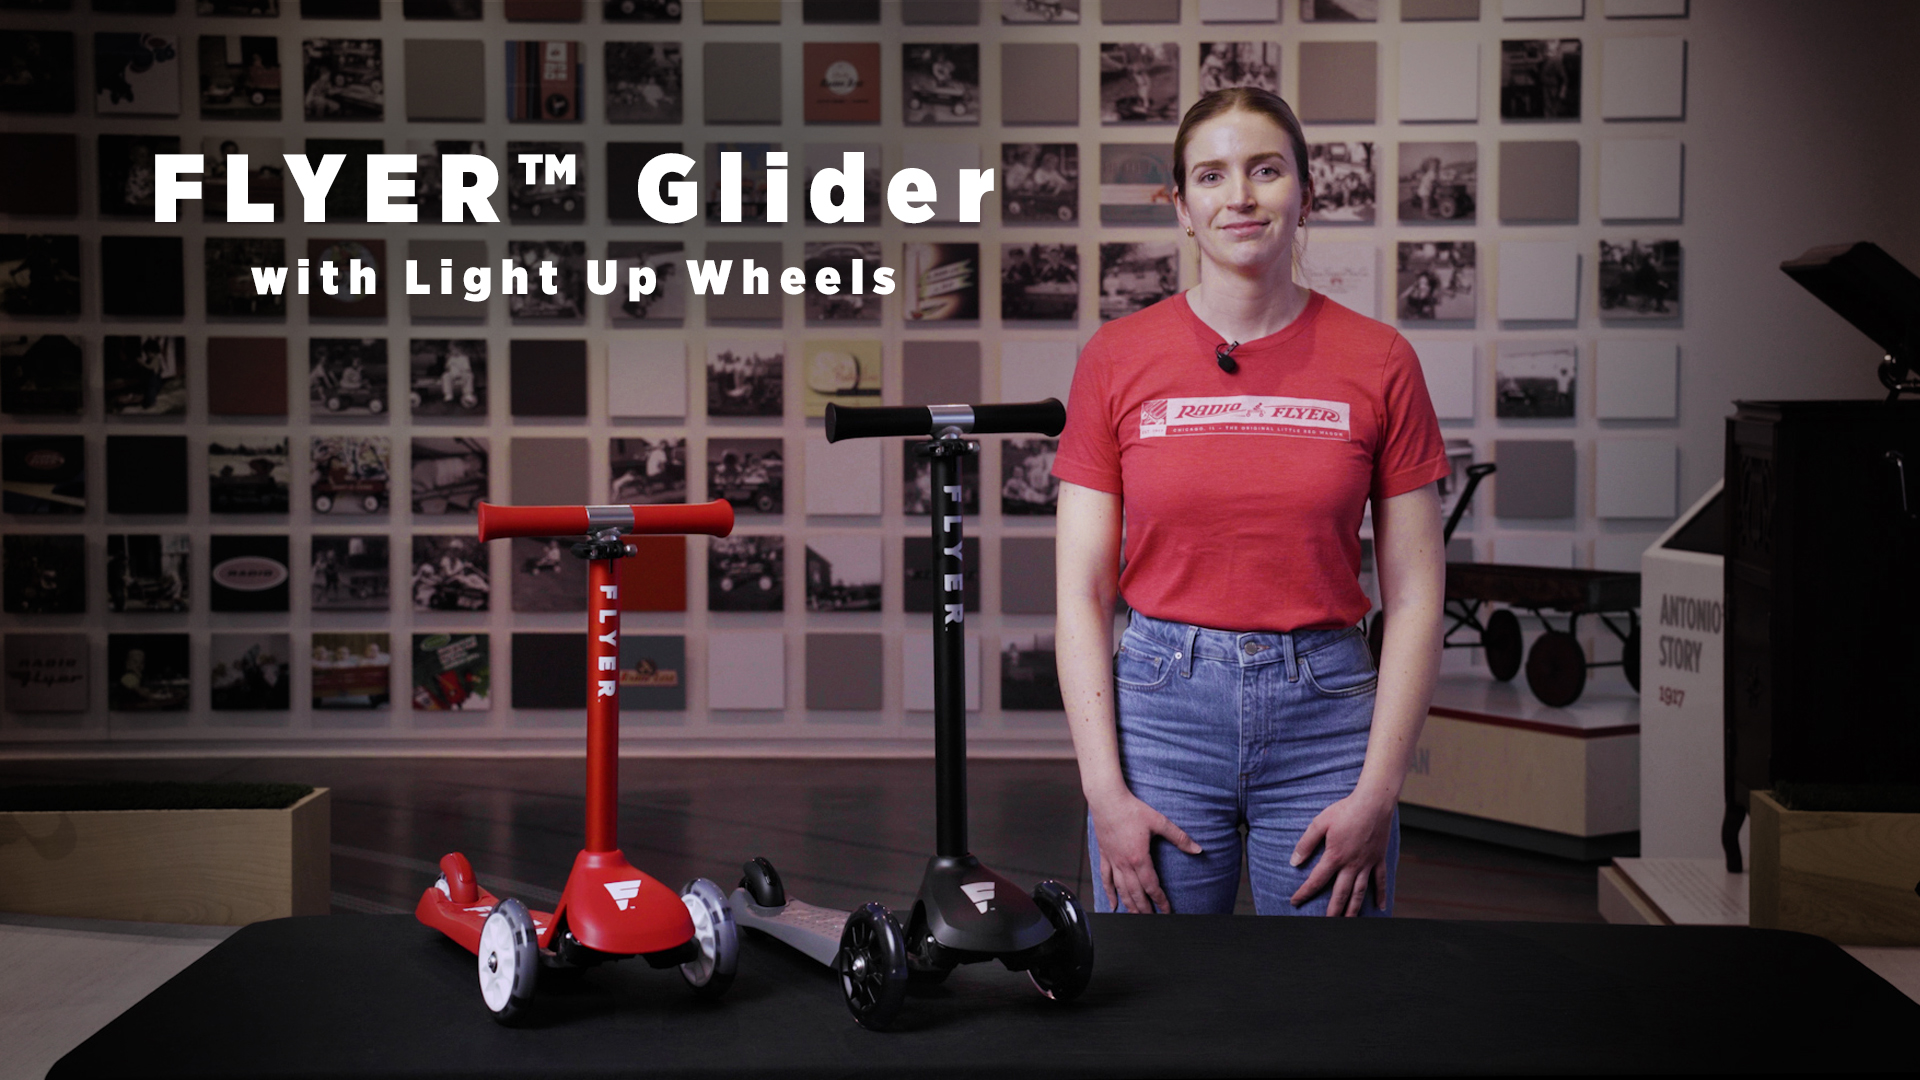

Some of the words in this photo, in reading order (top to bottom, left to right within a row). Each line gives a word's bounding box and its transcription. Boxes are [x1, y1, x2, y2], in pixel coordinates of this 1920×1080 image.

[1174, 403, 1244, 419] RADIO
[1271, 406, 1341, 423] FLYER
[943, 485, 964, 625] FLYER
[1659, 593, 1724, 635] ANTONIO
[597, 584, 618, 698] FLYER
[1659, 634, 1703, 673] STORY
[1659, 685, 1686, 708] 1917
